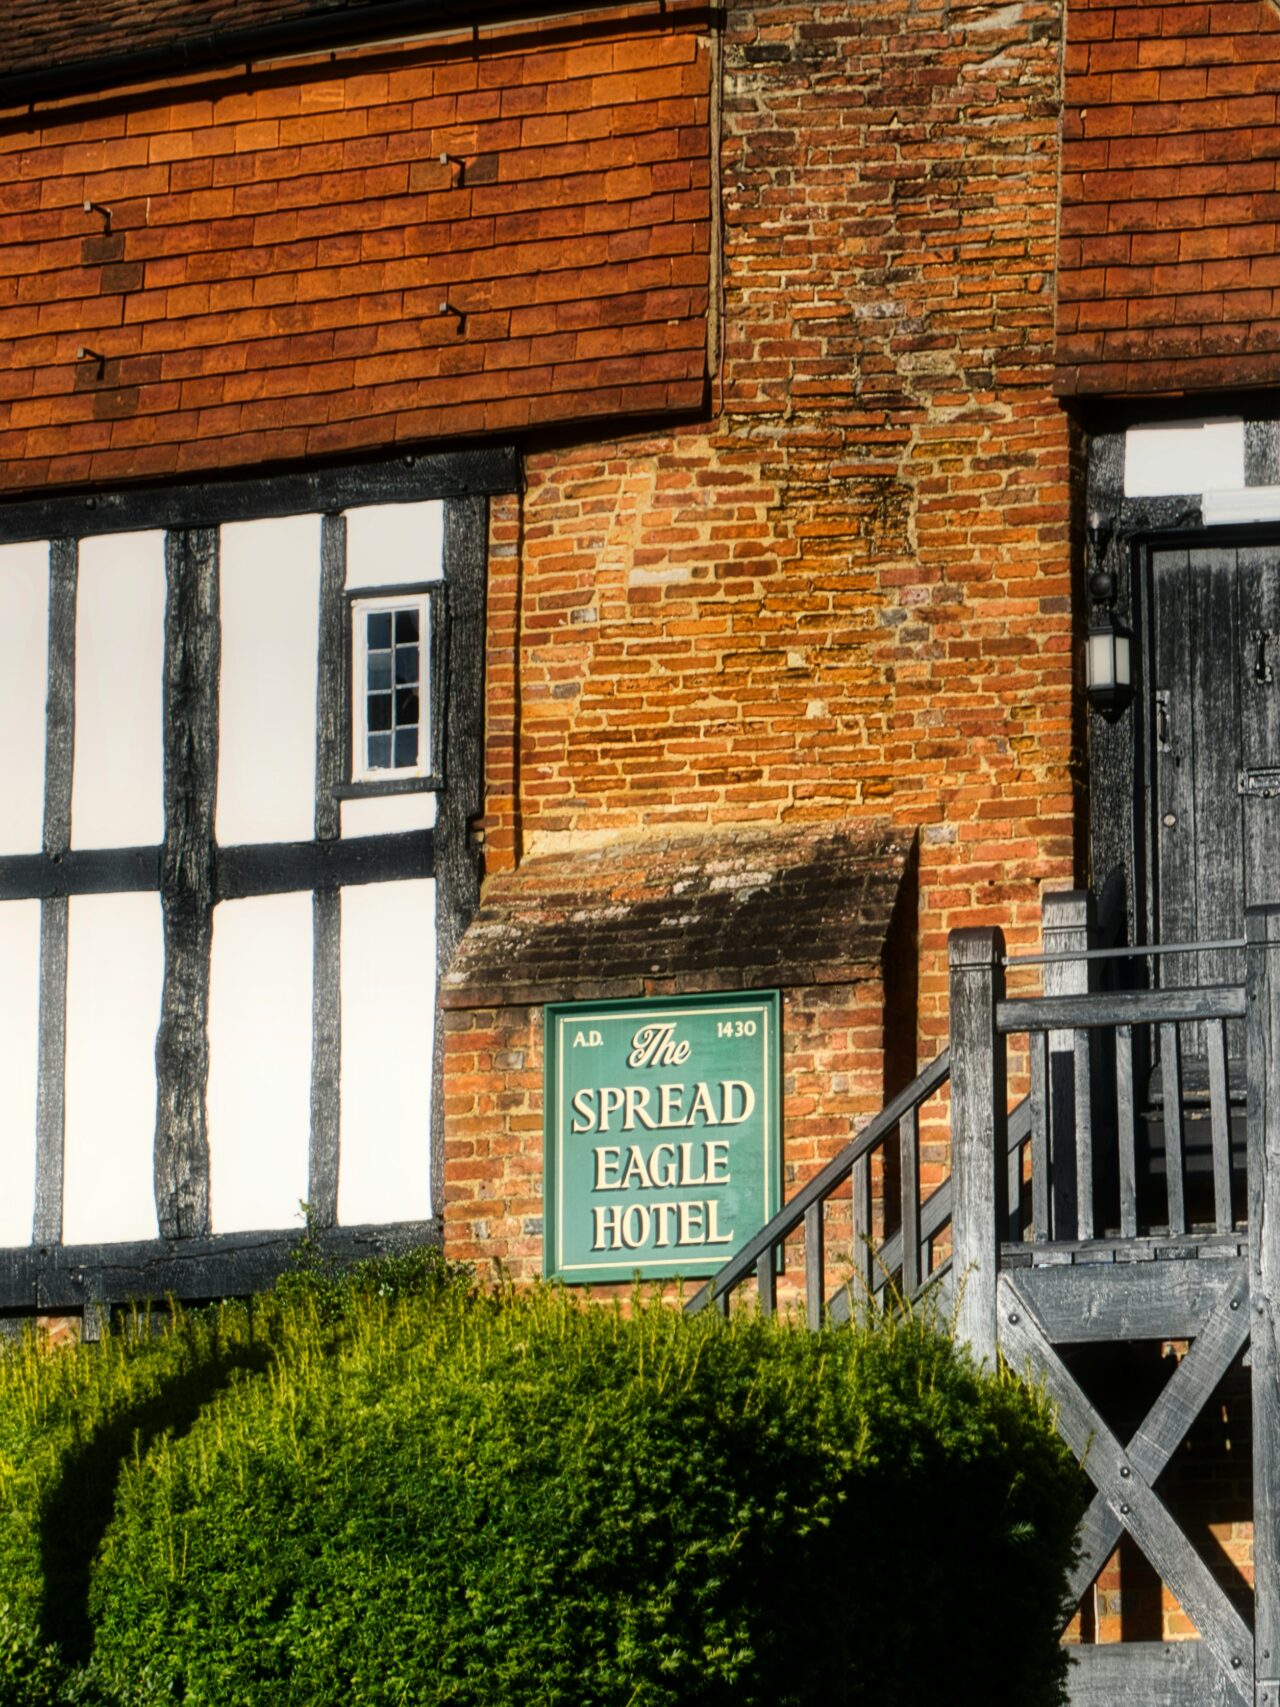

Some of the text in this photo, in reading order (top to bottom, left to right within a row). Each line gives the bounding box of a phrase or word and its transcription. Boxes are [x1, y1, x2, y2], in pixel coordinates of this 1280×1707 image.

[573, 1020, 757, 1047] A.D. 1430
[628, 1022, 692, 1068] The
[572, 1080, 756, 1132] SPREAD
[593, 1140, 731, 1191] EAGLE
[592, 1200, 734, 1249] HOTEL
